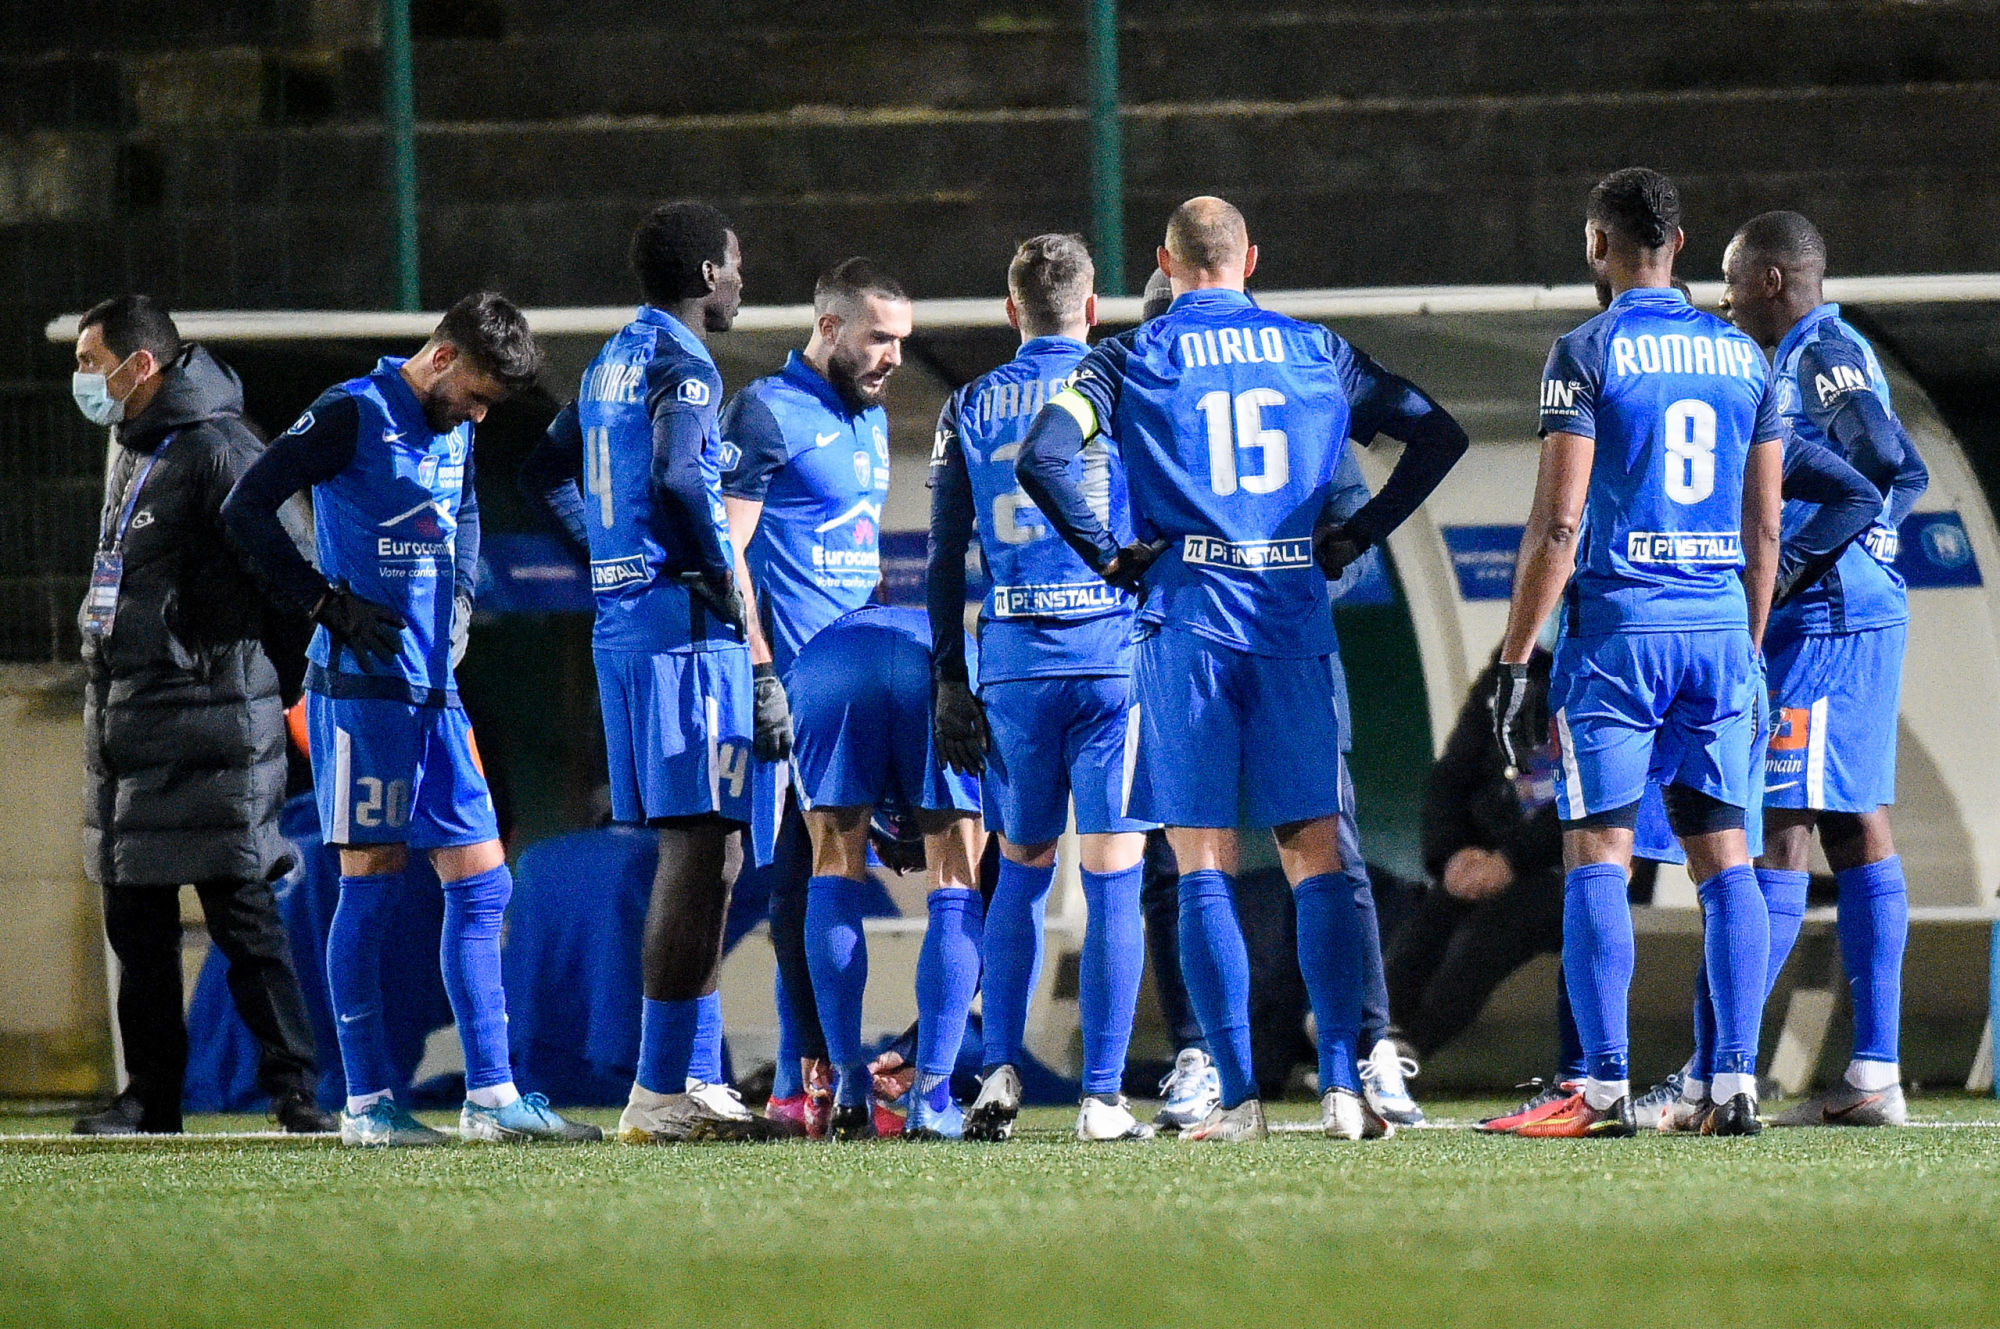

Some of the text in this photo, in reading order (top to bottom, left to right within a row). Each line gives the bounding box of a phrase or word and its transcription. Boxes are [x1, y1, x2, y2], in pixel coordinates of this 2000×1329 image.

[1180, 327, 1285, 368] NIRLO
[1613, 334, 1753, 379] ROMANY
[1815, 365, 1866, 403] AIN
[1195, 387, 1290, 497] 15
[1664, 398, 1717, 505] 8
[586, 425, 614, 530] 4
[379, 566, 406, 578] Votre
[719, 743, 748, 798] 4
[356, 776, 408, 828] 20
